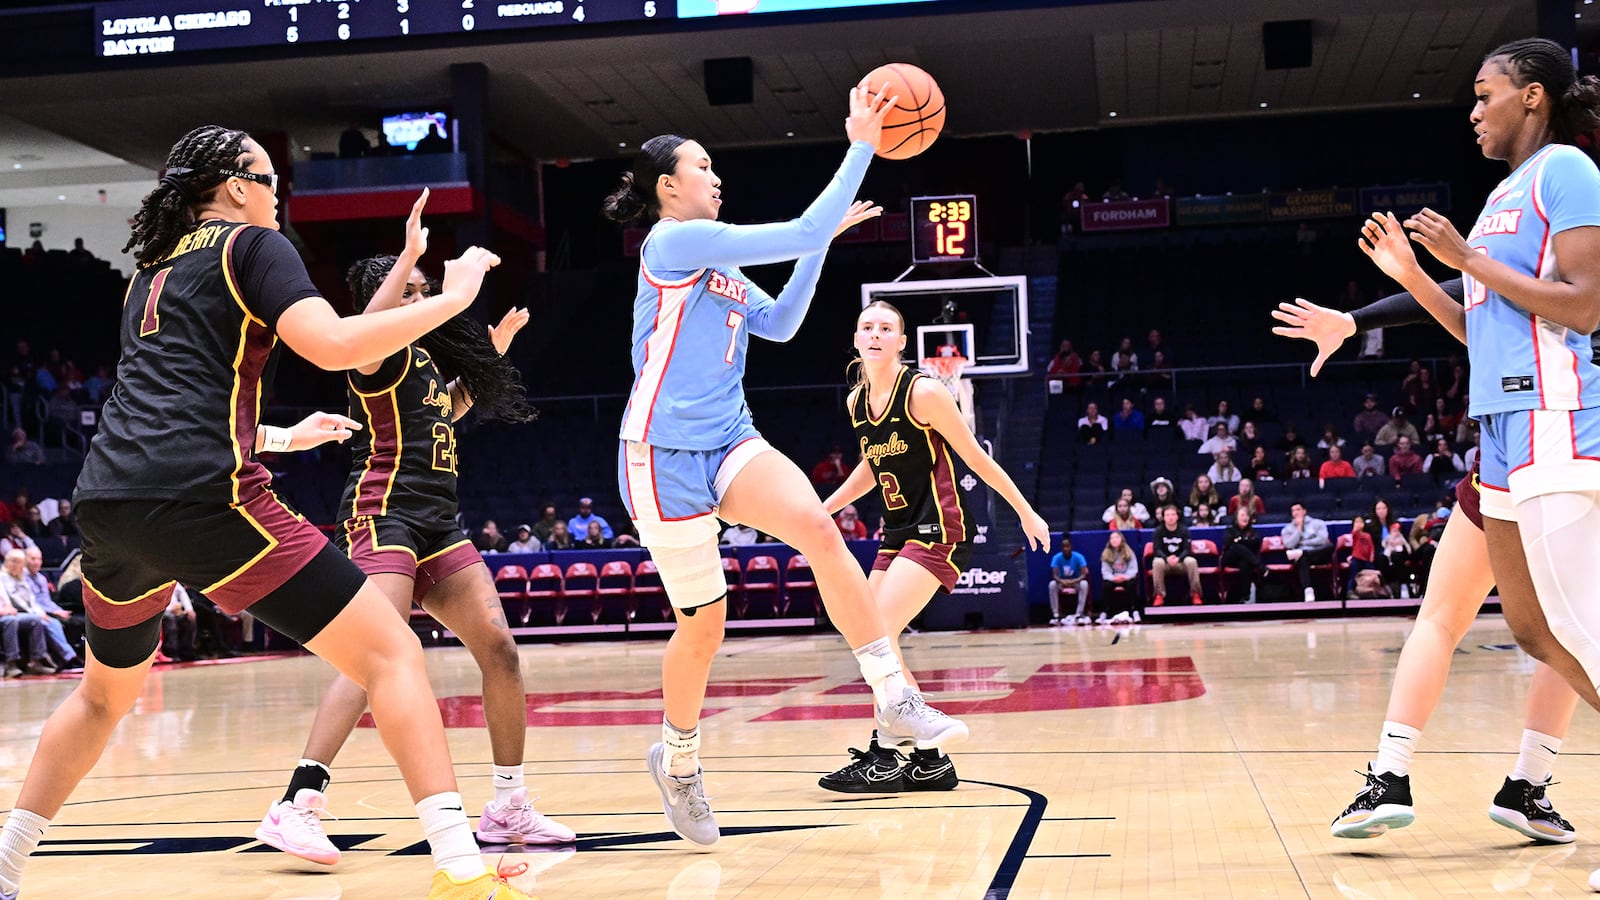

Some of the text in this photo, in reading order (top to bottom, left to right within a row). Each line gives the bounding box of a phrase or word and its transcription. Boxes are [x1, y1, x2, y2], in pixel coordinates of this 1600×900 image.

[102, 15, 172, 35] LOYOLA
[174, 10, 251, 30] CHICAGO
[287, 6, 297, 22] 1
[337, 3, 350, 19] 2
[497, 1, 656, 22] REBOUNDS 4 5
[102, 14, 473, 56] DAYTON 5 6 1 0
[929, 201, 970, 222] 2:33
[1093, 208, 1157, 222] FORDHAM
[1271, 202, 1353, 217] WASHINGTON
[1285, 191, 1335, 205] GEORGE
[936, 221, 965, 255] 12
[139, 266, 174, 337] 1
[725, 309, 745, 365] 7
[422, 378, 453, 418] Loy
[432, 421, 459, 478] 2
[859, 431, 909, 466] Loyola
[879, 472, 909, 511] 2
[956, 567, 1008, 588] afiber
